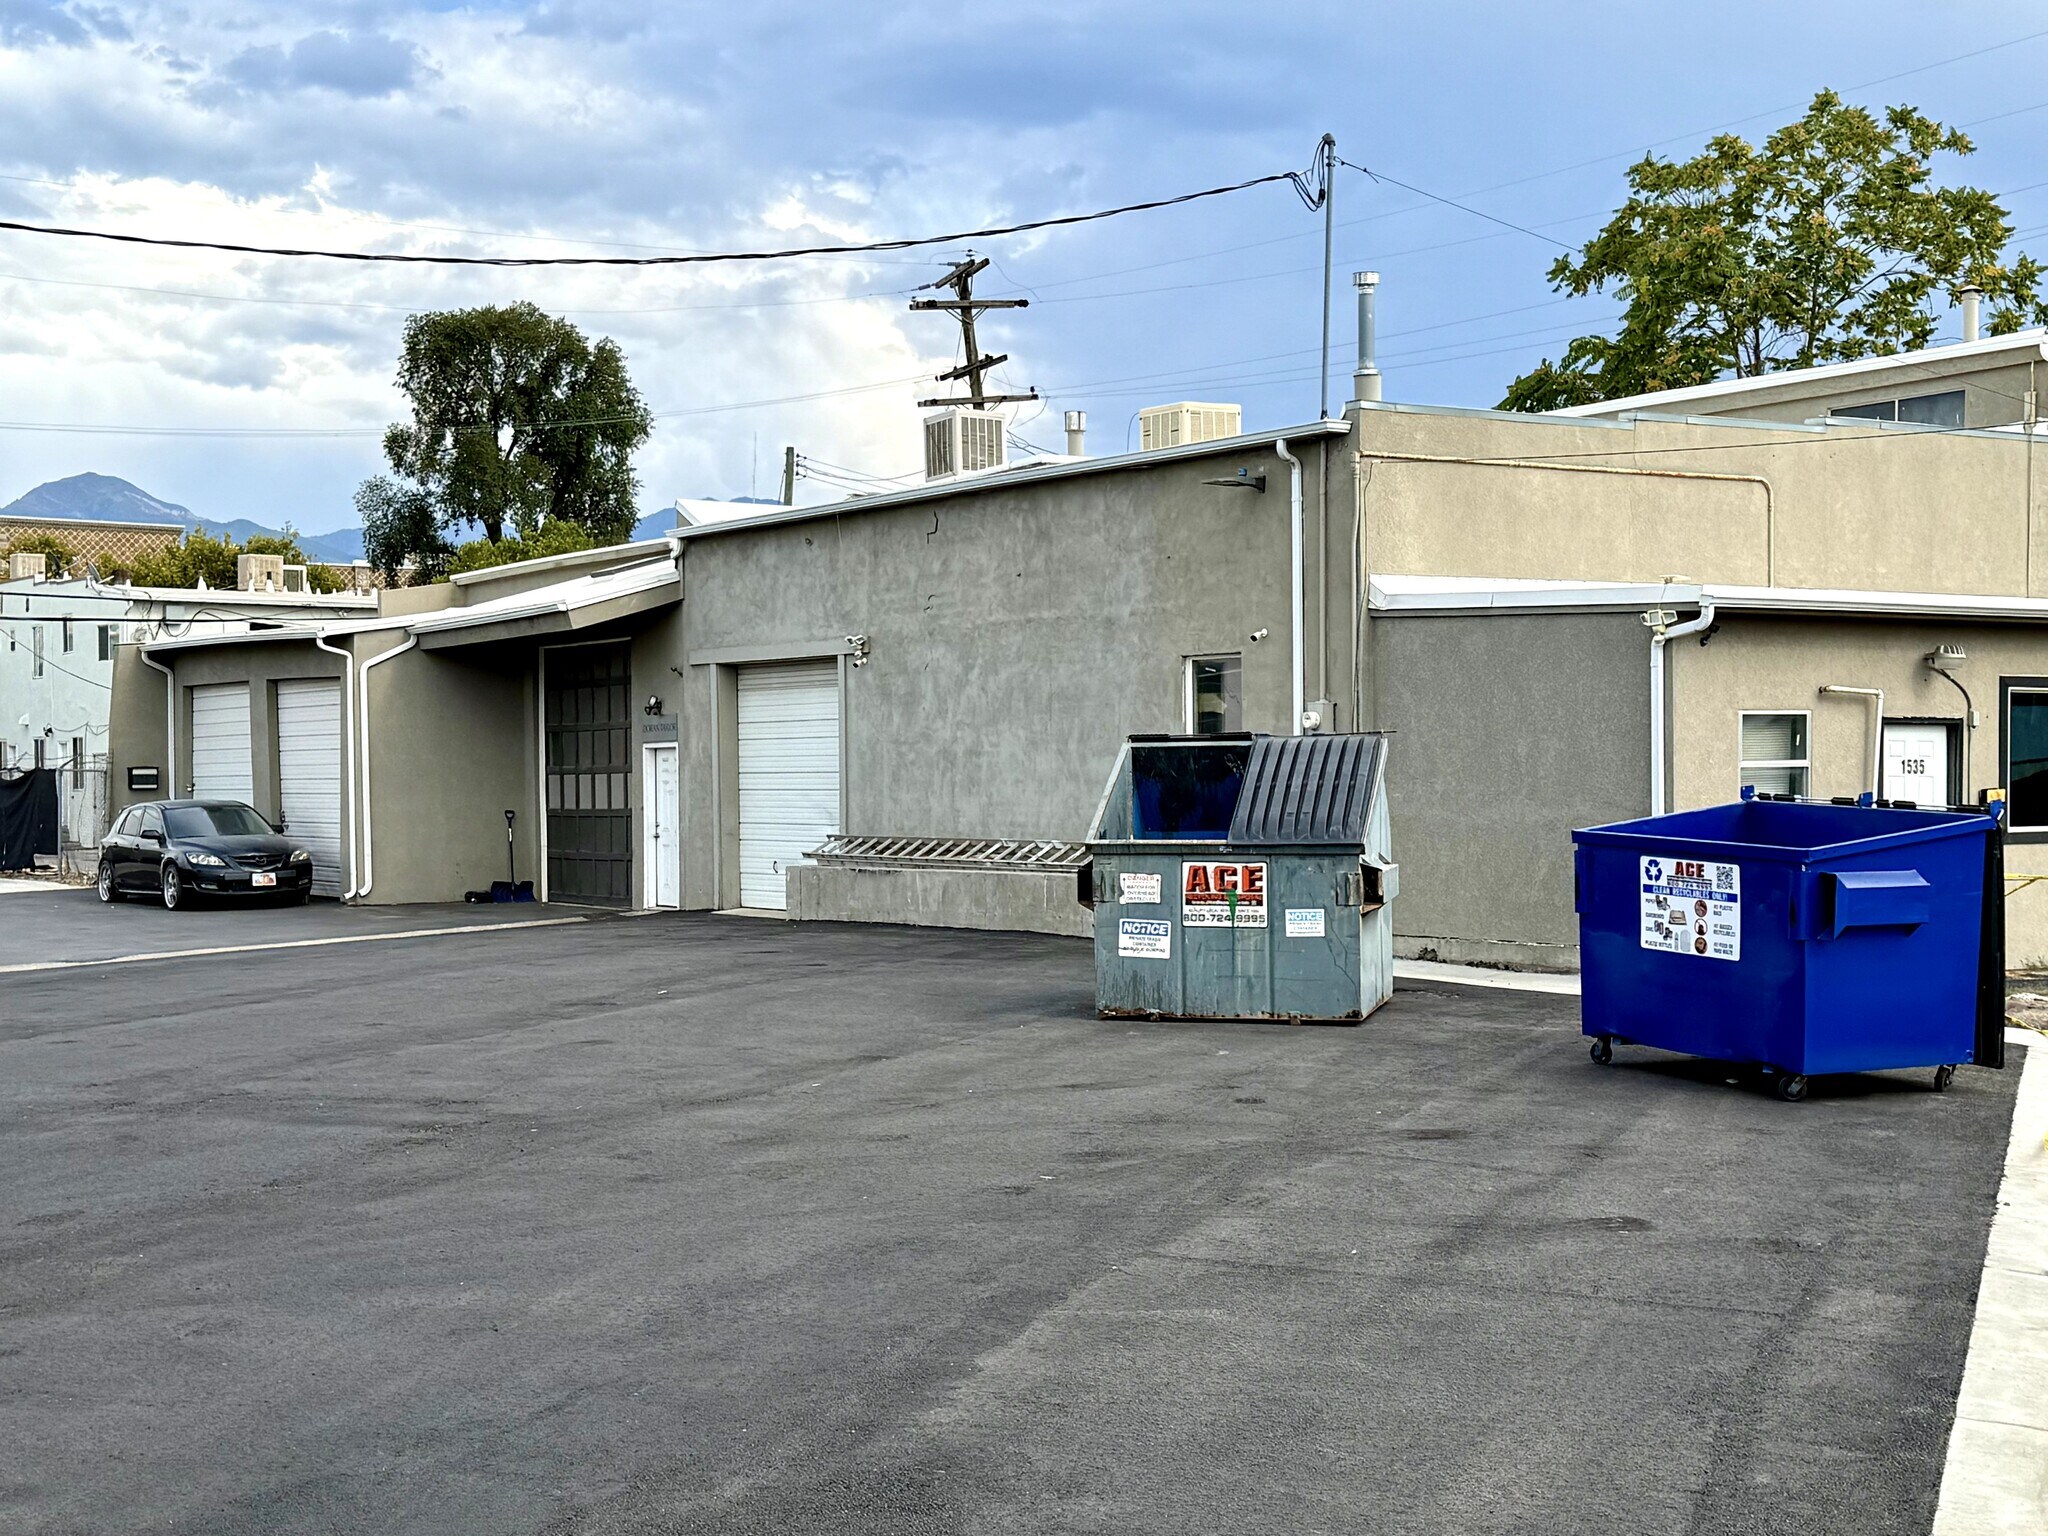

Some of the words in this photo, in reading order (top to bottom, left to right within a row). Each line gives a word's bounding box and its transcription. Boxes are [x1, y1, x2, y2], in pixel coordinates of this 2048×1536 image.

[1901, 759, 1925, 775] 1535
[1675, 861, 1705, 878] ACE
[1186, 865, 1263, 892] ACE
[1652, 886, 1671, 895] CLEAN
[1672, 888, 1710, 899] RECYCLABLES
[1288, 912, 1323, 920] NOTICE
[1122, 922, 1168, 935] NOTICE
